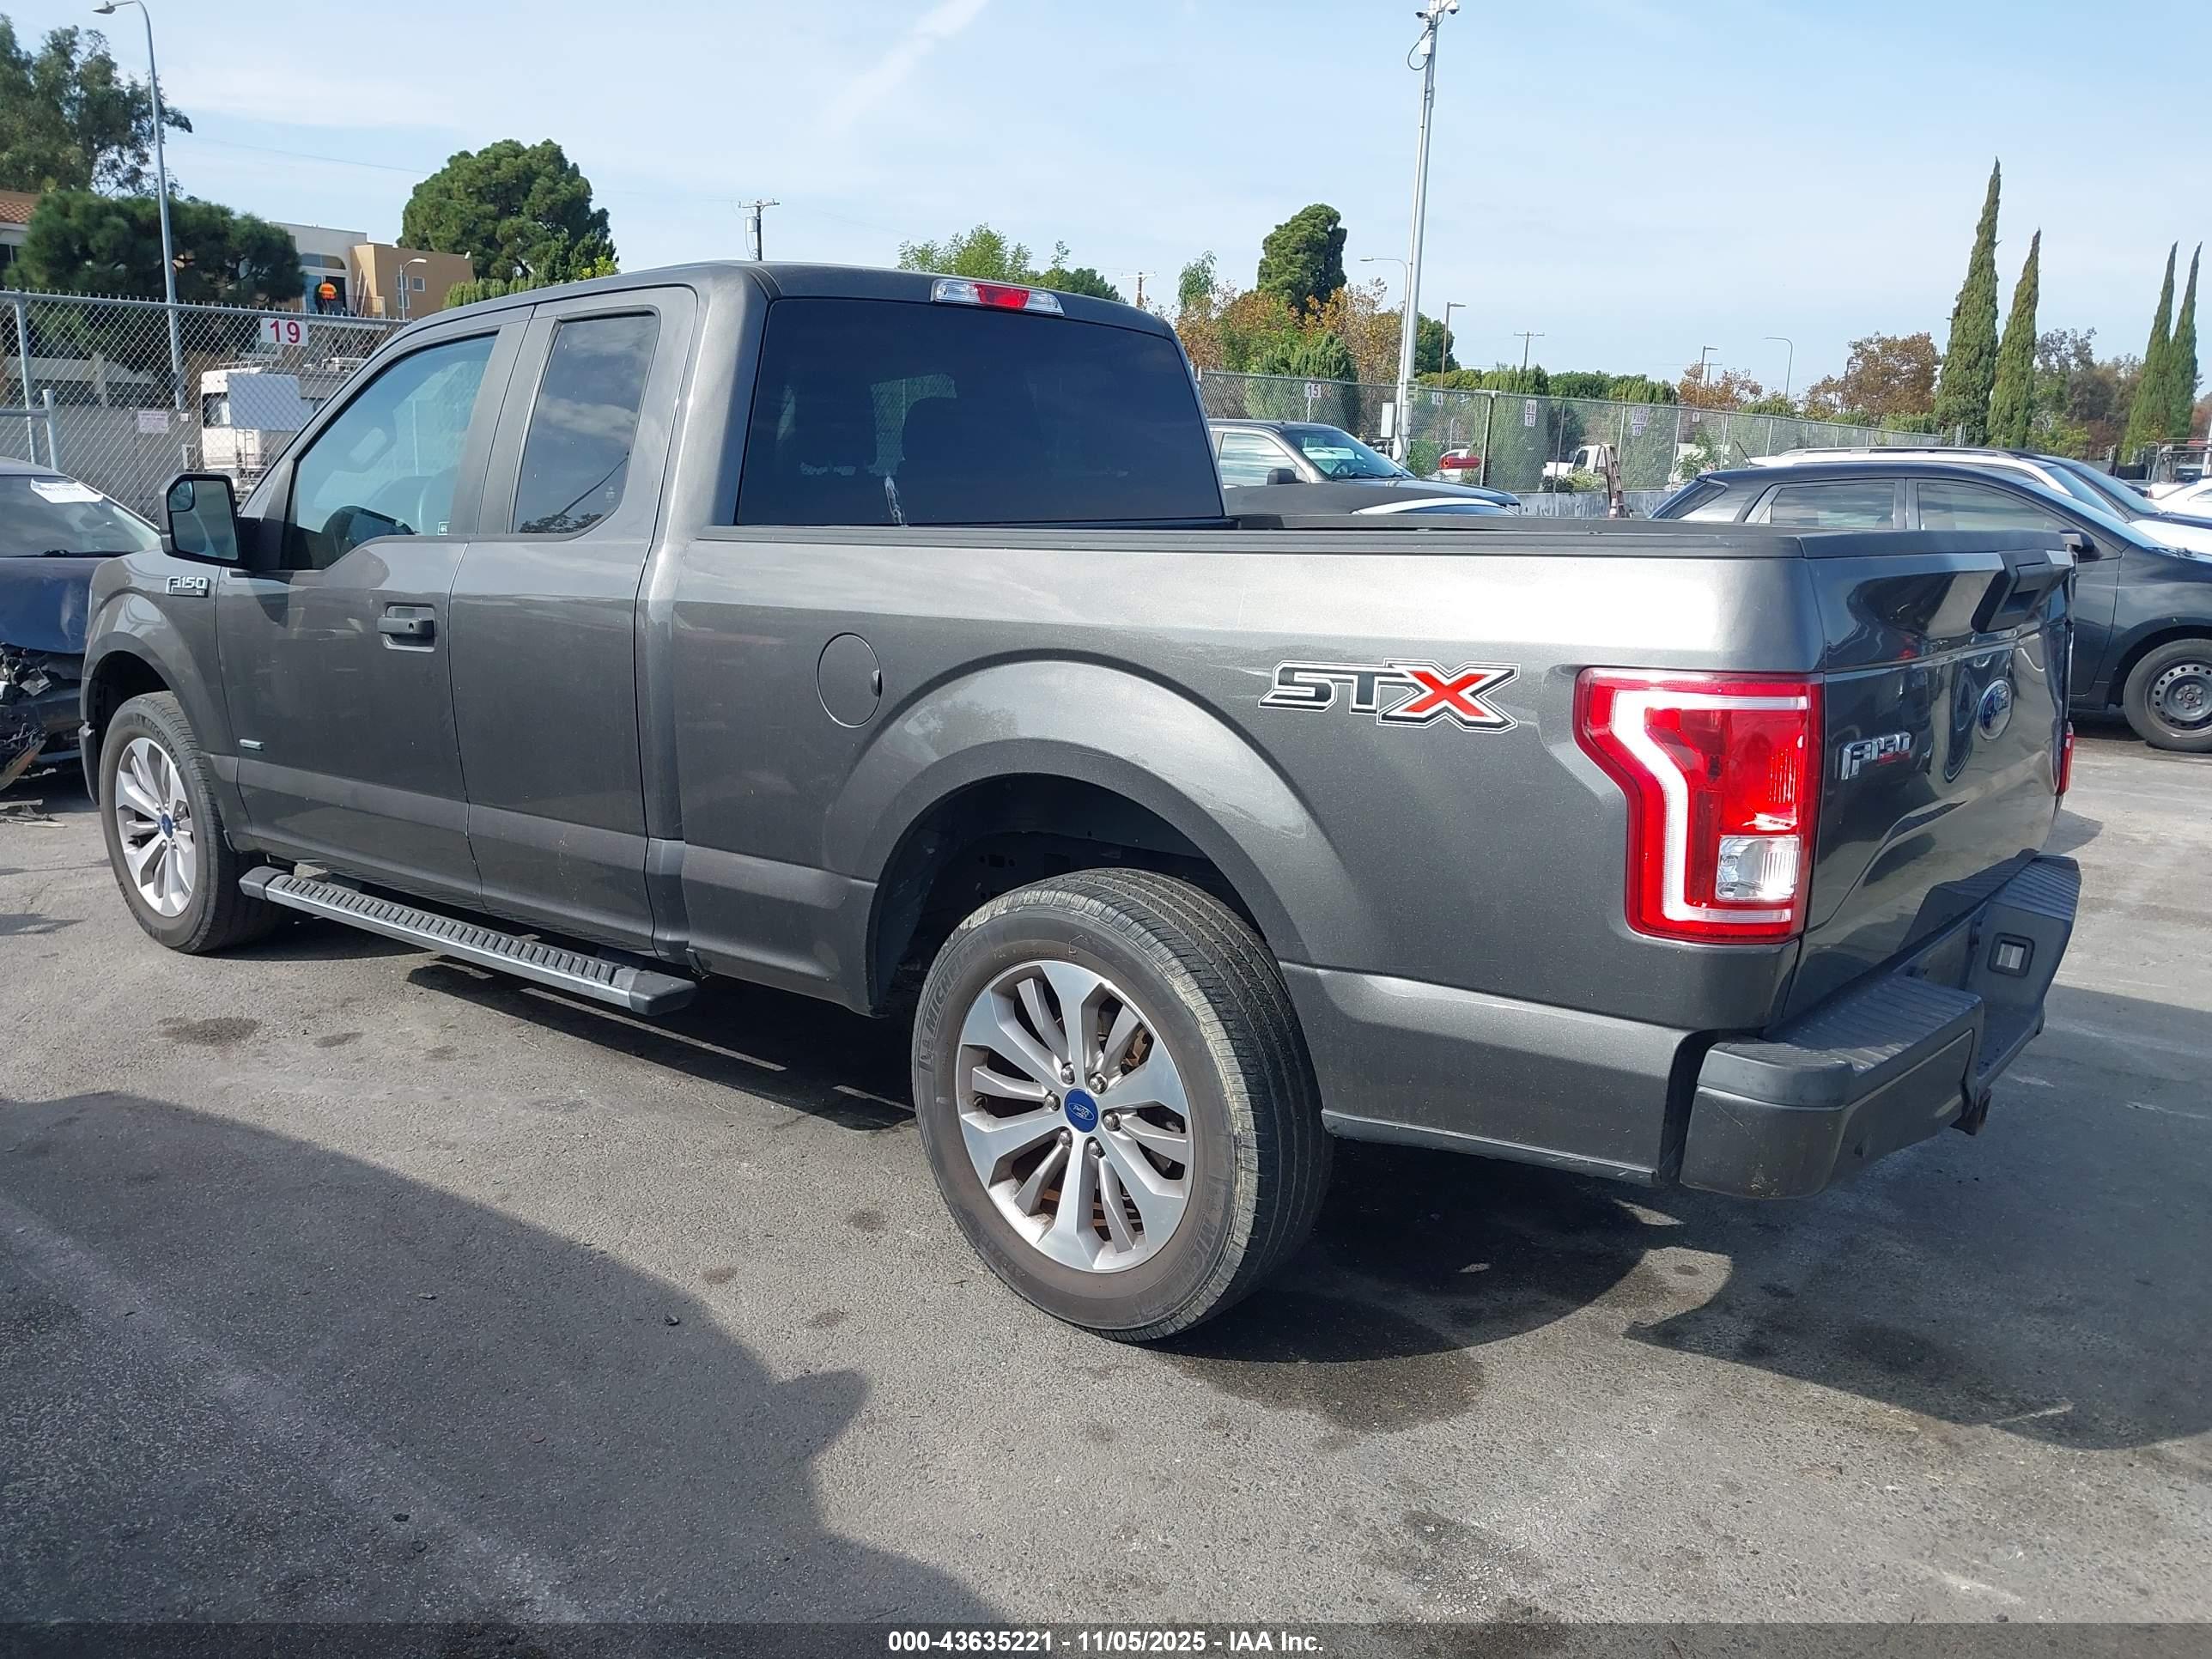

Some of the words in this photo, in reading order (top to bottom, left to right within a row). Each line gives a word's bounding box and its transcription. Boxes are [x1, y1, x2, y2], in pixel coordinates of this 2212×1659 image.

[270, 319, 301, 343] 19
[1308, 384, 1319, 396] 15
[1258, 658, 1521, 734] STX
